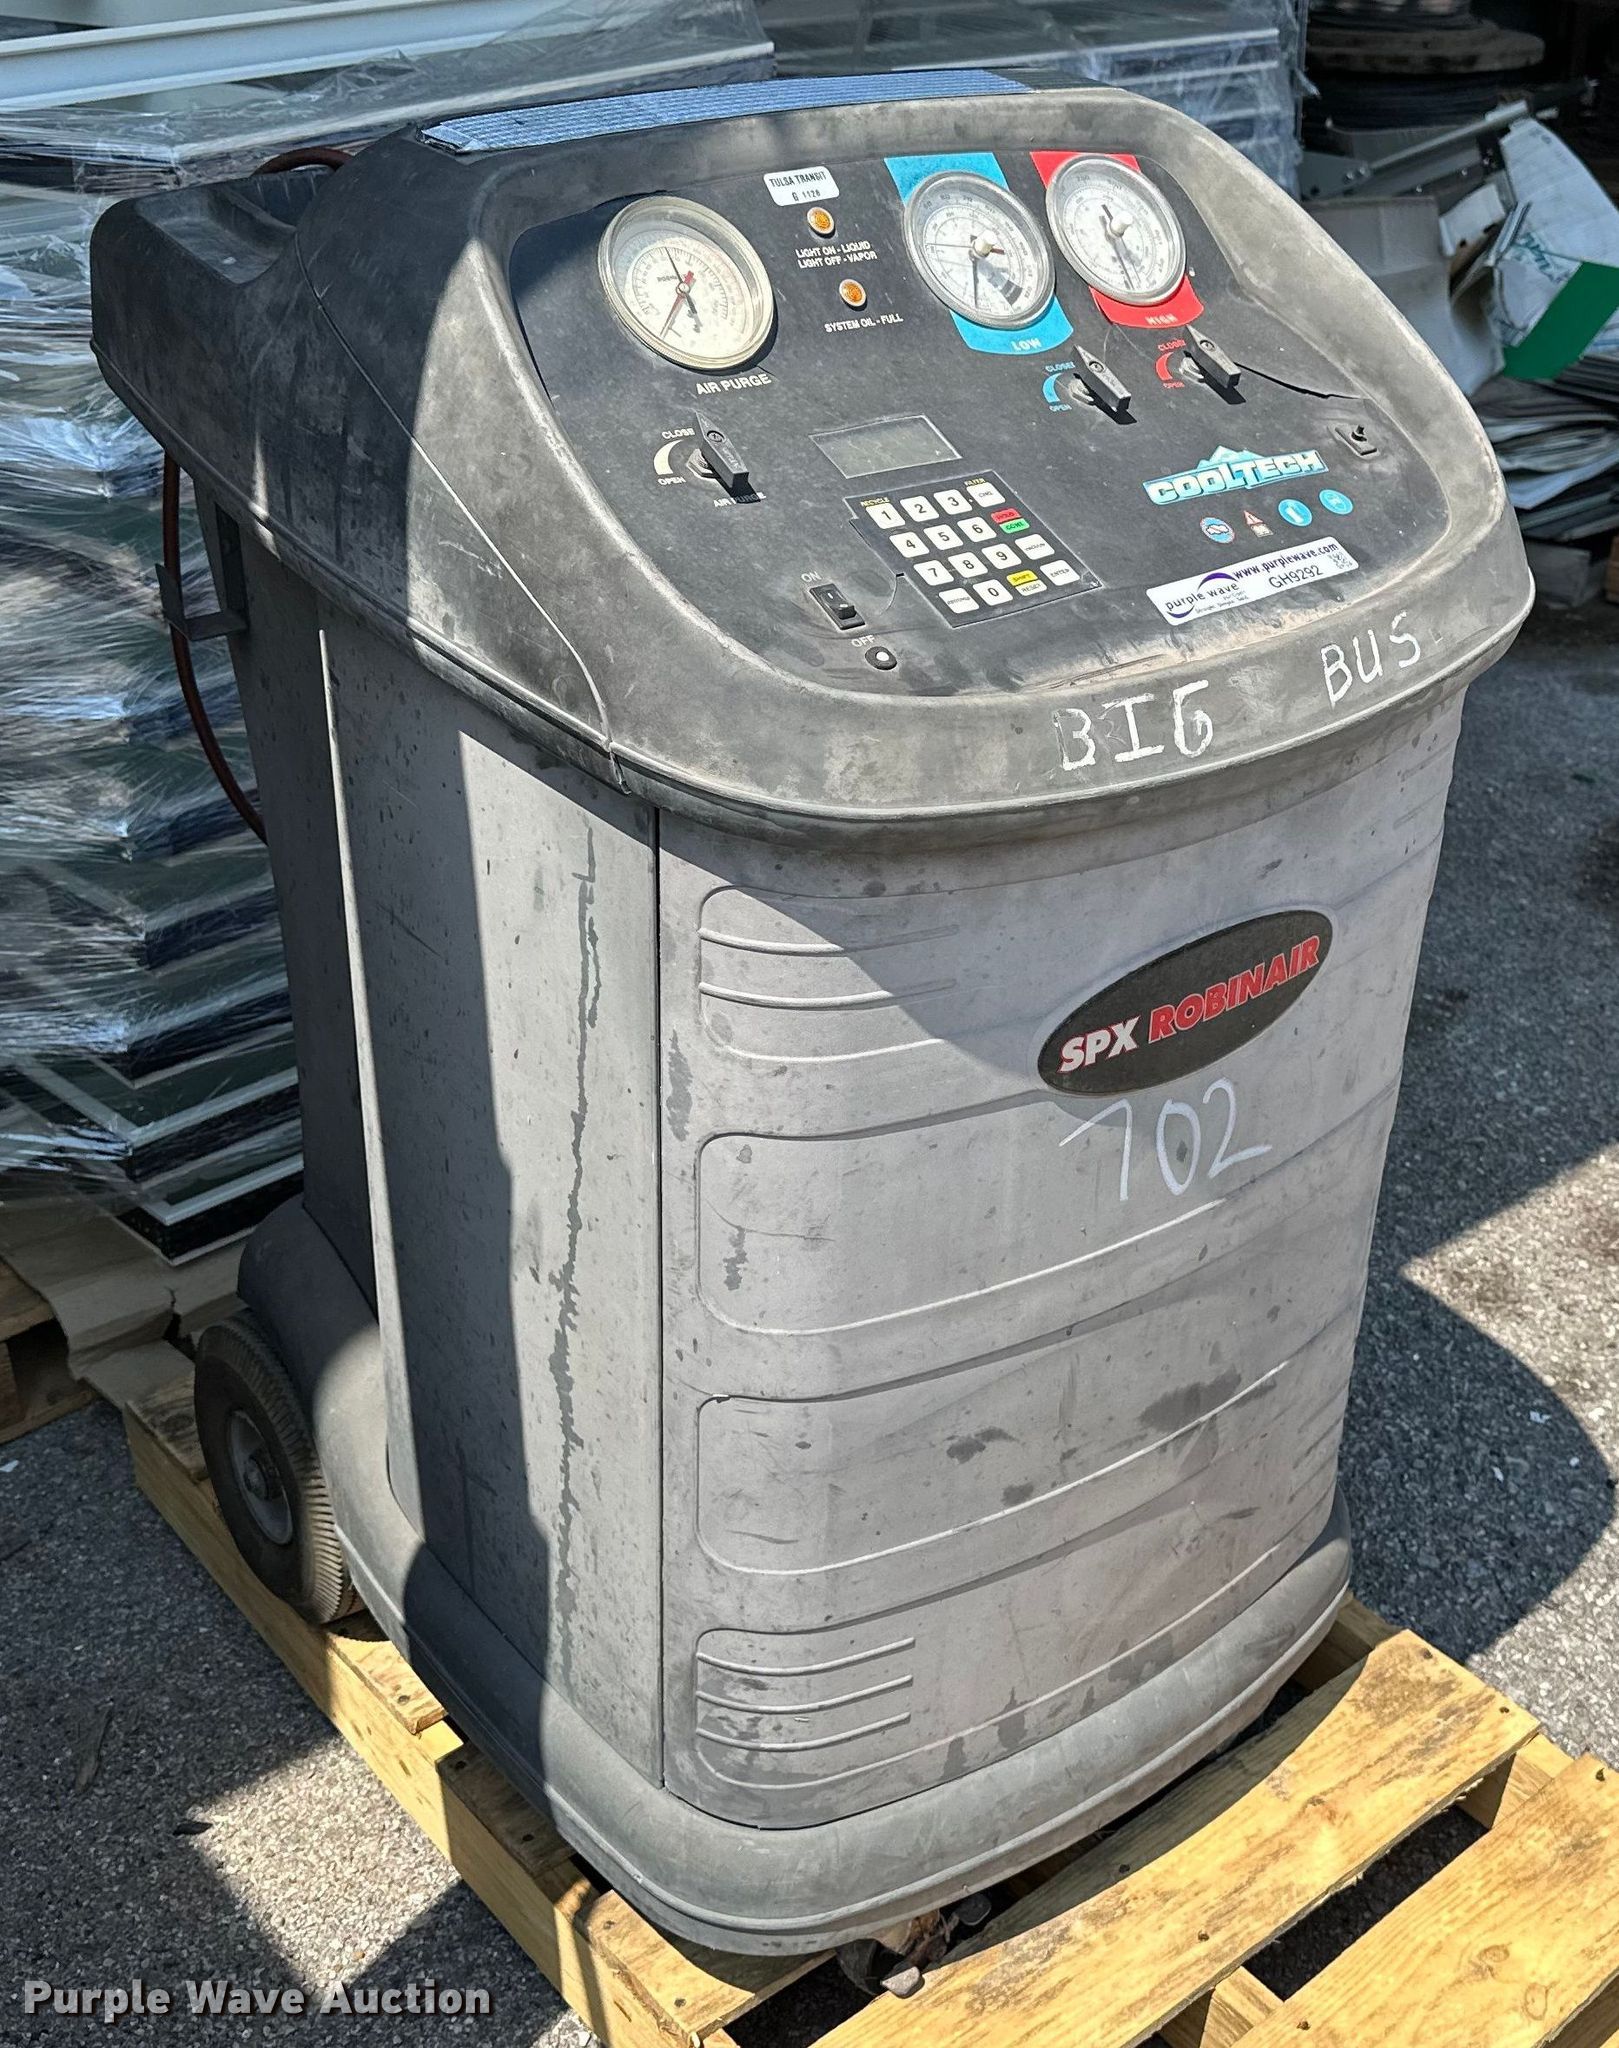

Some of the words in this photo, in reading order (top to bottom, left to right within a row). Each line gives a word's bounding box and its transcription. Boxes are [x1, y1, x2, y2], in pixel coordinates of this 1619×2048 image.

[769, 176, 795, 187] TULSA
[795, 171, 827, 183] TRANSIT
[795, 247, 821, 258] LIGHT
[822, 245, 836, 255] ON
[841, 240, 870, 253] LIQUID
[797, 258, 823, 269] LIGHT
[824, 255, 841, 265] OFF
[847, 251, 877, 263] VAPOR
[824, 320, 860, 333] SYSTEM
[860, 317, 876, 327] OIL
[880, 313, 904, 324] FULL
[1146, 313, 1177, 326] HIGH
[1010, 338, 1042, 351] LOW
[696, 381, 721, 395] AIR
[720, 373, 772, 391] PURGE
[1049, 404, 1073, 412] OPEN
[661, 427, 695, 439] CLOSE
[658, 476, 686, 485] OPEN
[1147, 450, 1326, 504] COOLTECH
[713, 498, 731, 507] AIR
[947, 496, 960, 507] 3
[914, 503, 927, 514] 2
[881, 510, 892, 520] 1
[972, 524, 984, 534] 6
[938, 531, 950, 542] 5
[906, 540, 917, 549] 4
[996, 551, 1008, 561] 9
[1233, 542, 1339, 582] www.purplewave.com
[963, 560, 975, 570] 8
[801, 571, 822, 583] ON
[928, 568, 938, 578] 7
[1050, 568, 1070, 578] ENTER
[1268, 565, 1323, 588] GH9292
[987, 587, 999, 597] 0
[1021, 583, 1041, 593] RESET
[1165, 592, 1205, 612] purple
[1207, 583, 1239, 598] wave
[851, 635, 875, 647] OFF
[1054, 680, 1213, 771] BIG
[1321, 611, 1421, 708] BUS
[1057, 1015, 1142, 1074] SPX
[1148, 935, 1320, 1044] ROBINAIR
